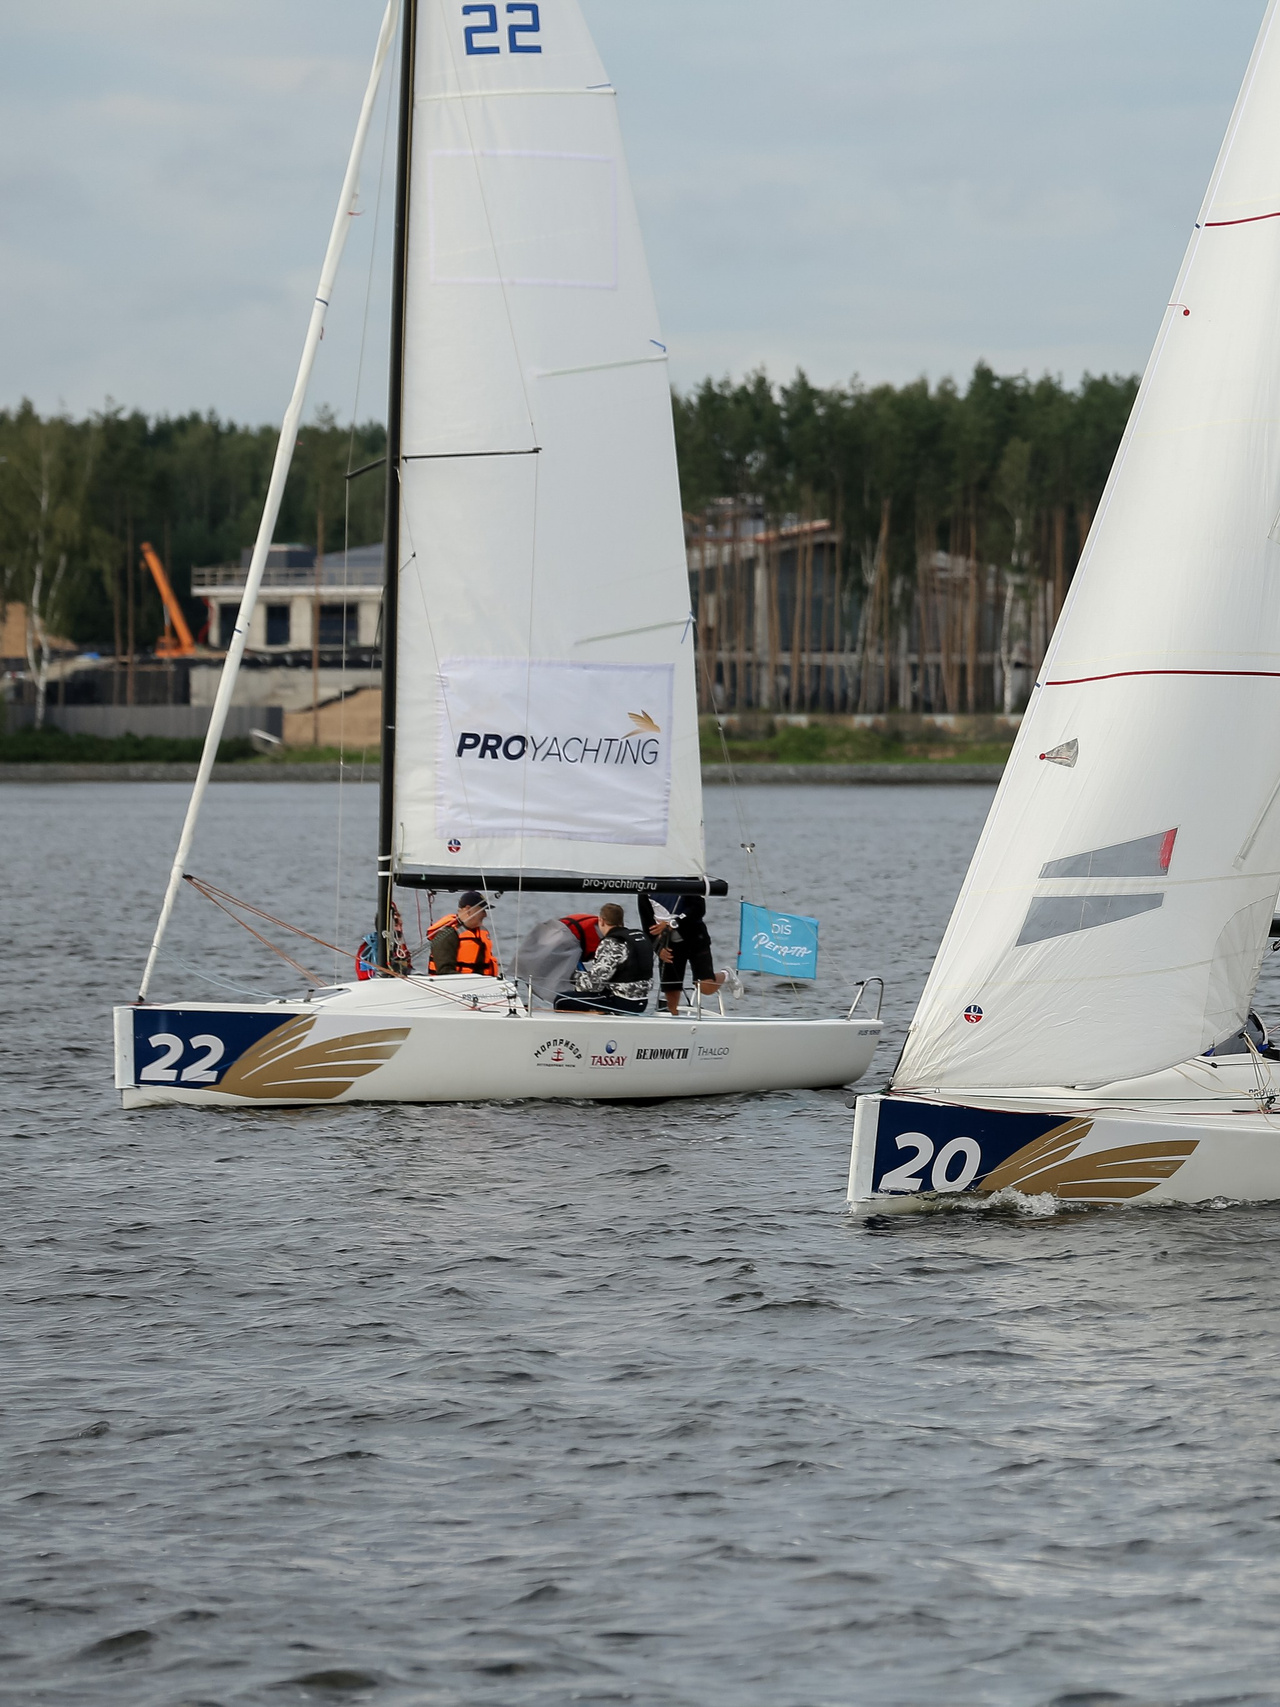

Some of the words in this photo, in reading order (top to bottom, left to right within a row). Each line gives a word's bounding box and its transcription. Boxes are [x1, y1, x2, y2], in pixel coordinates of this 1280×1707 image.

[462, 3, 542, 55] 22
[455, 732, 660, 765] PROYACHTING
[582, 878, 657, 892] pro-yachting.ru
[771, 923, 792, 935] DIS
[140, 1033, 225, 1082] 22
[533, 1038, 583, 1060] МОРПРИБОР
[636, 1048, 689, 1060] ВЕДОМОСТИ
[590, 1055, 628, 1067] TASSAY
[878, 1131, 981, 1193] 20
